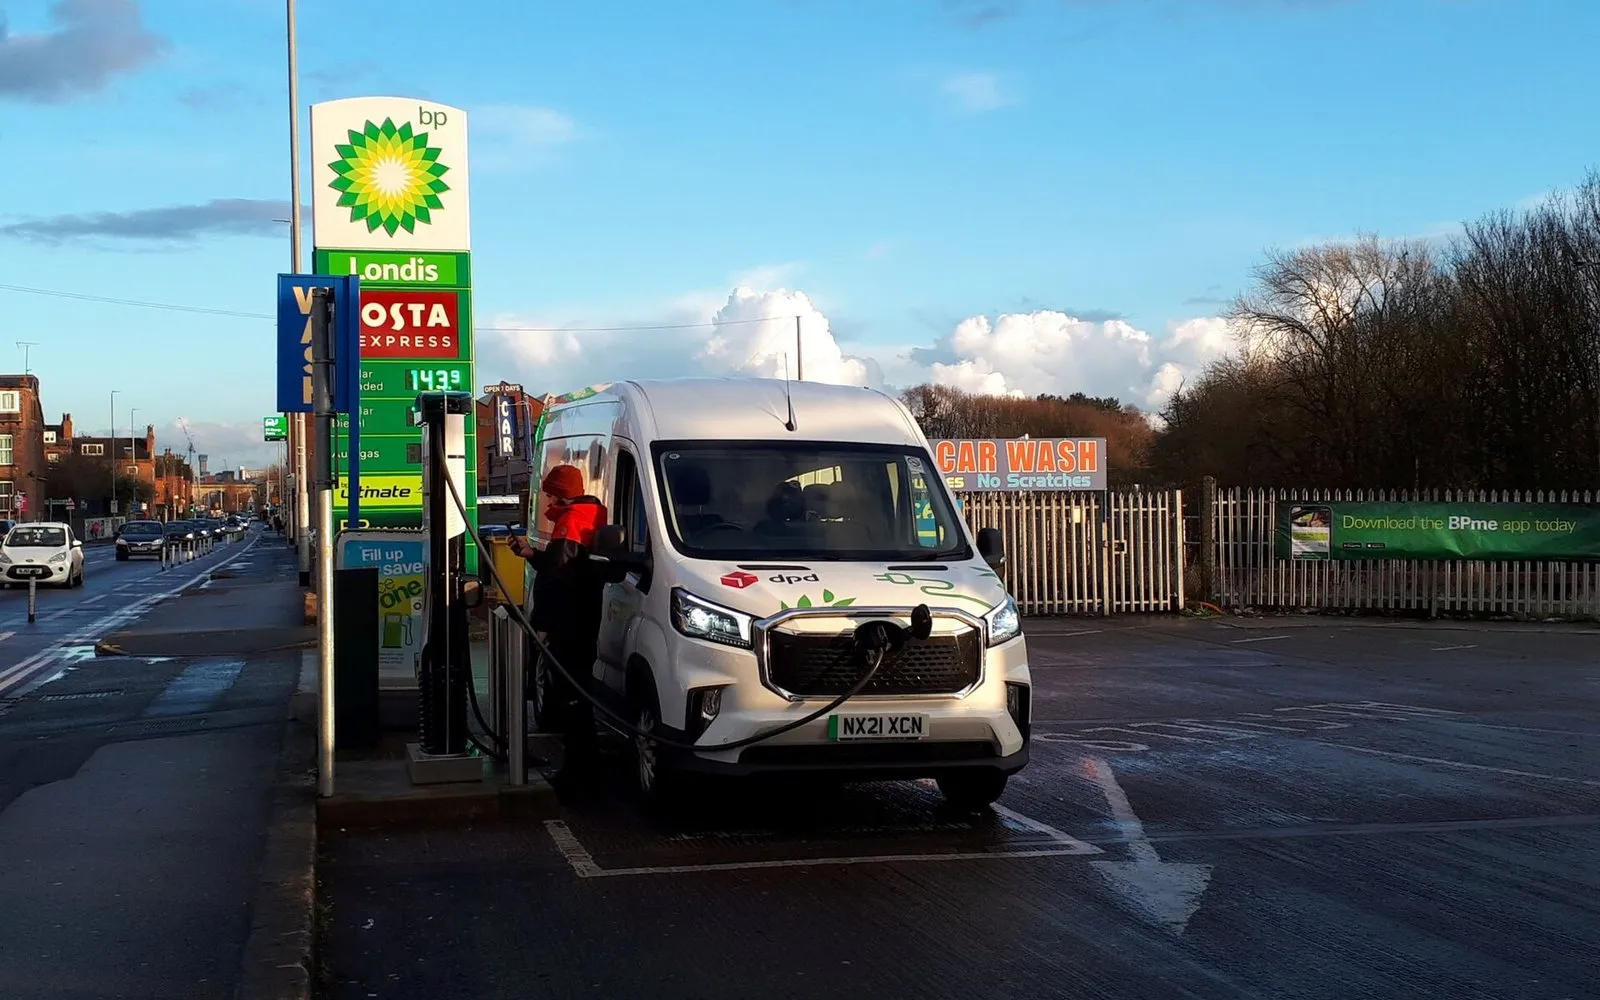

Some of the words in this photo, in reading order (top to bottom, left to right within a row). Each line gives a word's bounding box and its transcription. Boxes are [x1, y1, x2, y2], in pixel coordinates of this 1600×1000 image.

[419, 106, 447, 129] bp
[350, 256, 438, 281] Londis
[360, 302, 450, 330] OSTA
[359, 335, 451, 348] EXPRESS
[501, 400, 513, 452] CAR
[935, 440, 997, 474] CAR
[1005, 440, 1098, 473] WASH
[977, 474, 1000, 488] No
[1007, 473, 1091, 488] Scratches
[1343, 515, 1416, 530] Download
[1421, 516, 1444, 530] the
[1448, 516, 1498, 531] BPme
[1503, 519, 1530, 533] app
[1535, 518, 1577, 534] today
[362, 548, 381, 561] Fill
[385, 550, 404, 562] up
[383, 562, 424, 575] save
[769, 573, 819, 585] dpd
[843, 717, 883, 735] NX21
[887, 716, 923, 734] XCN
